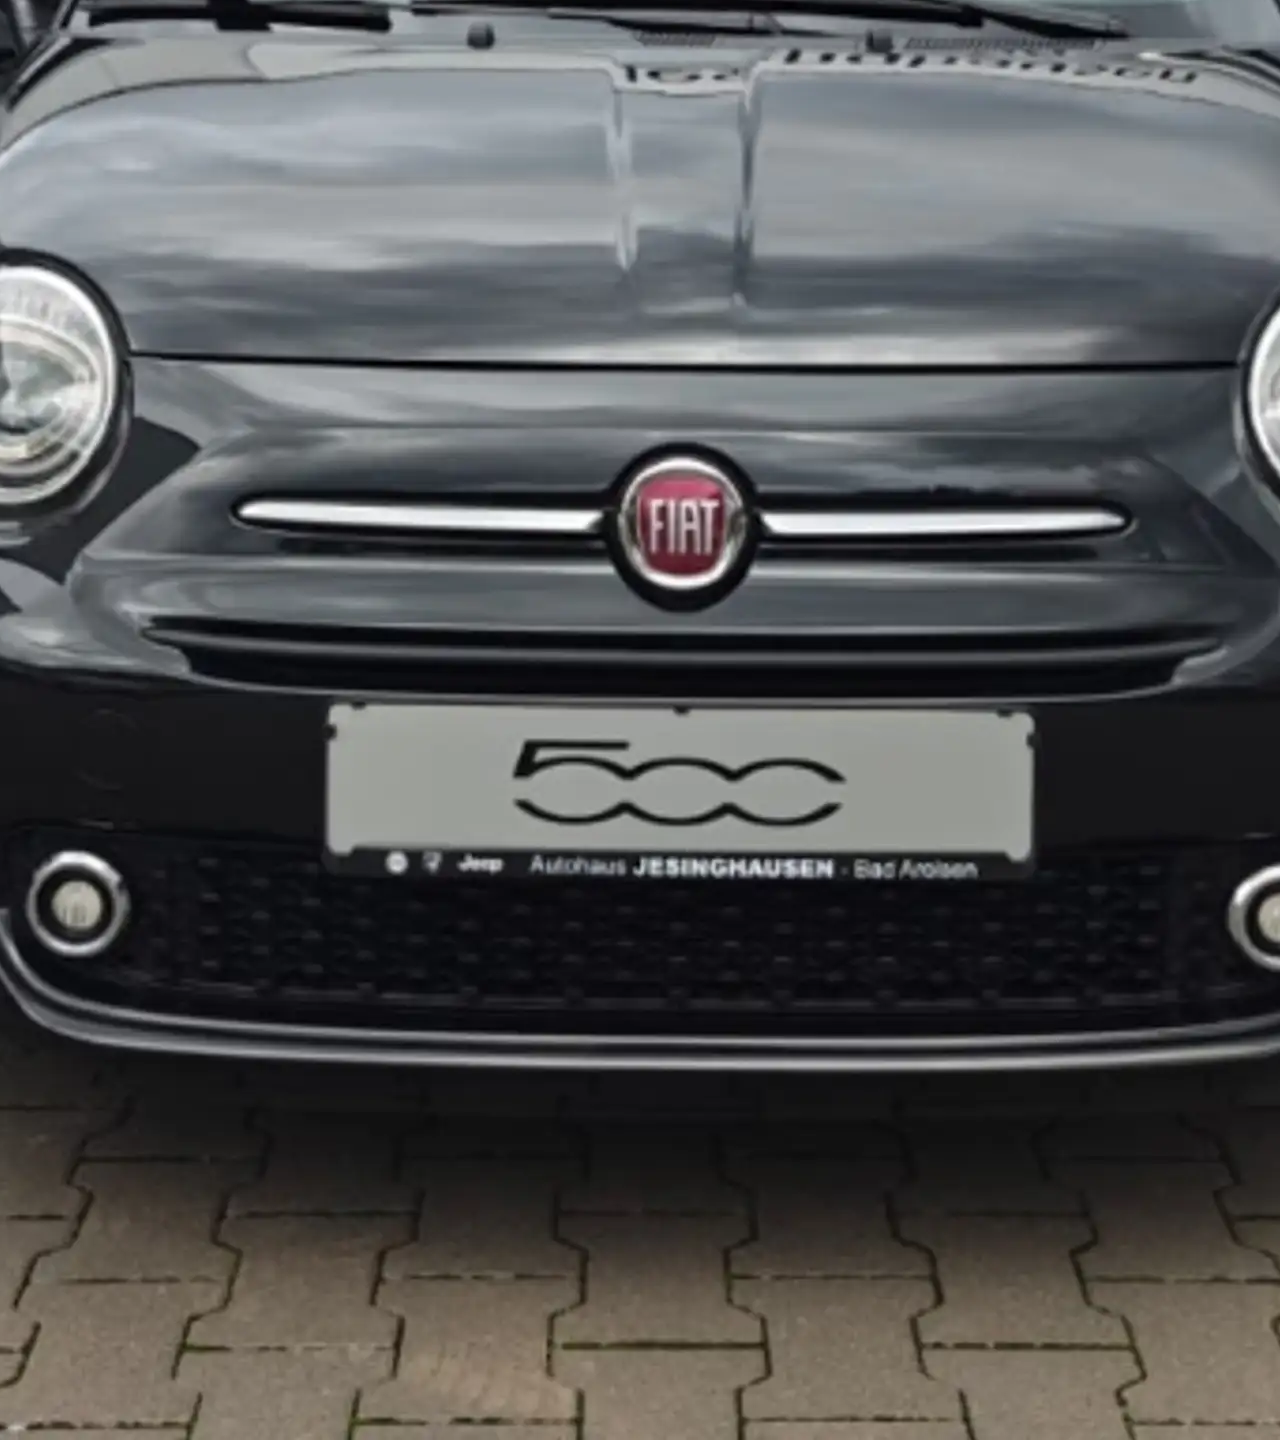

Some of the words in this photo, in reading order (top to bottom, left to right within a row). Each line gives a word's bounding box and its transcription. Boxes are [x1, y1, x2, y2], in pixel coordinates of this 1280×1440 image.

[649, 497, 720, 556] FIAT
[512, 739, 846, 826] 500
[530, 854, 627, 876] Autohaus
[633, 856, 833, 879] JESINGHAUSEN
[854, 858, 895, 880] Bad
